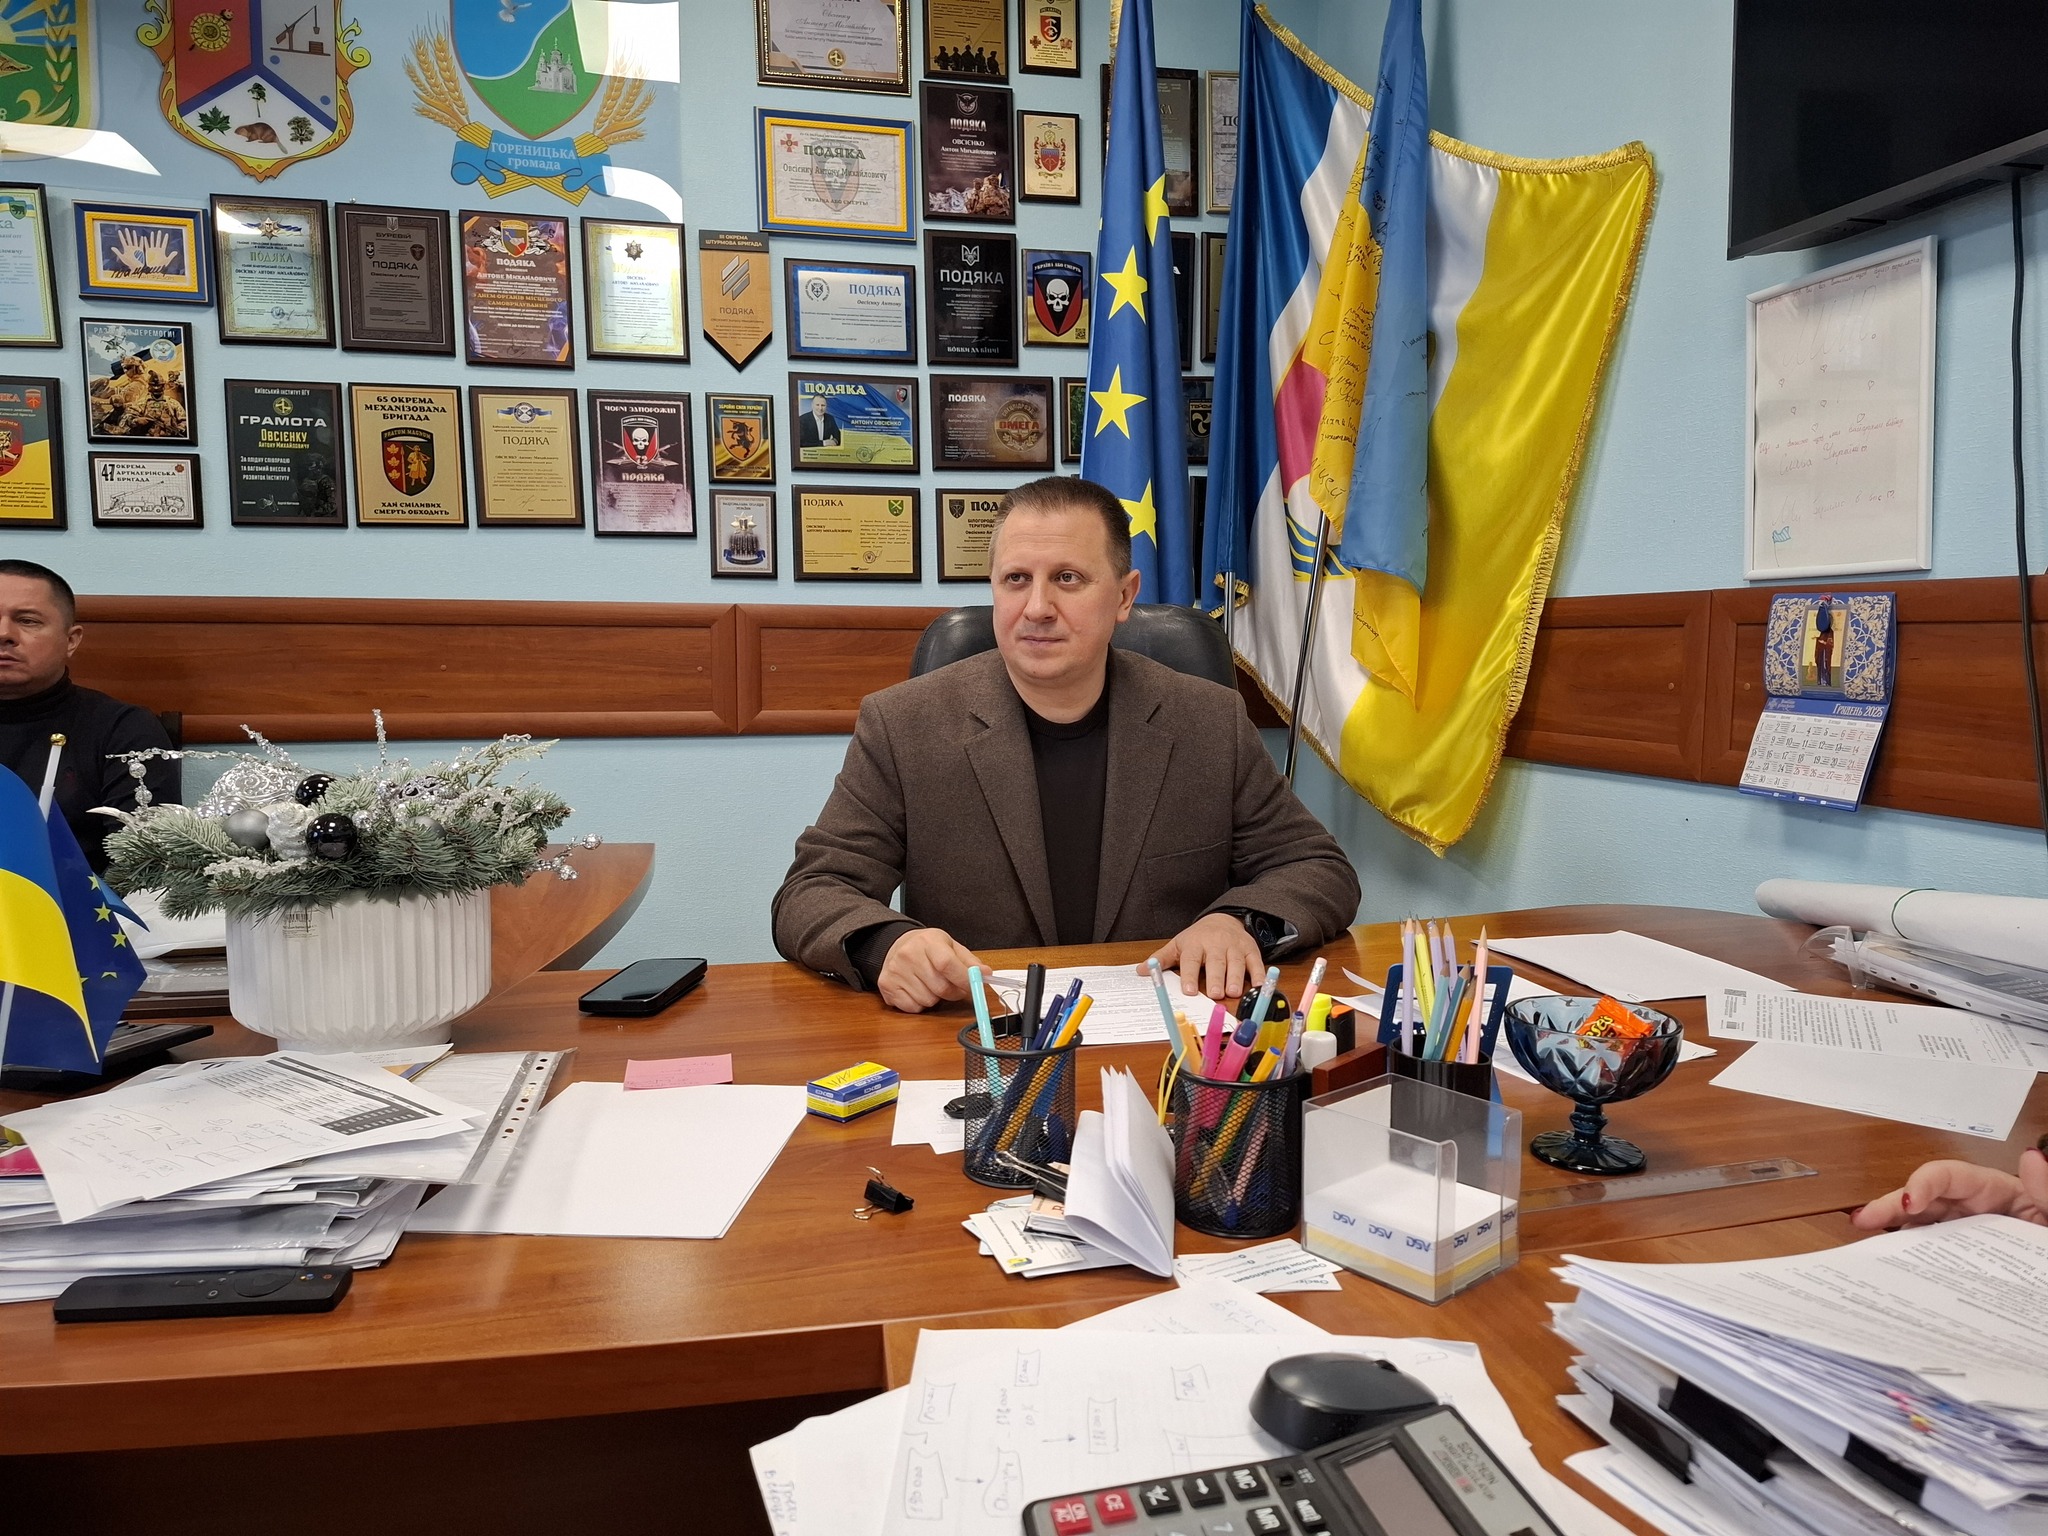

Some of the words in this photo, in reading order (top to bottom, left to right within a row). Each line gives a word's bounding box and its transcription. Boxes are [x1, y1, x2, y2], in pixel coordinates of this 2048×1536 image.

[950, 118, 987, 132] ПОДЯКА
[489, 141, 578, 160] ГОРЕНИЦЬКА
[804, 145, 866, 160] ПОДЯКА
[507, 156, 562, 173] громада
[250, 251, 292, 263] ПОДЯКА
[496, 258, 536, 268] ПОДЯКА
[372, 261, 418, 270] ПОДЯКА
[940, 270, 1004, 284] ПОДЯКА
[850, 284, 902, 296] ПОДЯКА
[720, 307, 754, 315] ПОДЯКА
[804, 382, 867, 396] ПОДЯКА
[948, 394, 986, 402] ПОДЯКА
[240, 416, 327, 427] ГРАМОТА
[1000, 421, 1040, 430] ОМЕГА
[502, 436, 550, 446] ПОДЯКА
[102, 464, 115, 482] 47
[622, 473, 664, 482] ПОДЯКА
[1233, 1469, 1257, 1490] MC
[1104, 1494, 1125, 1511] CE
[1056, 1507, 1071, 1523] AC
[1072, 1503, 1089, 1520] ON
[1255, 1507, 1281, 1530] MR
